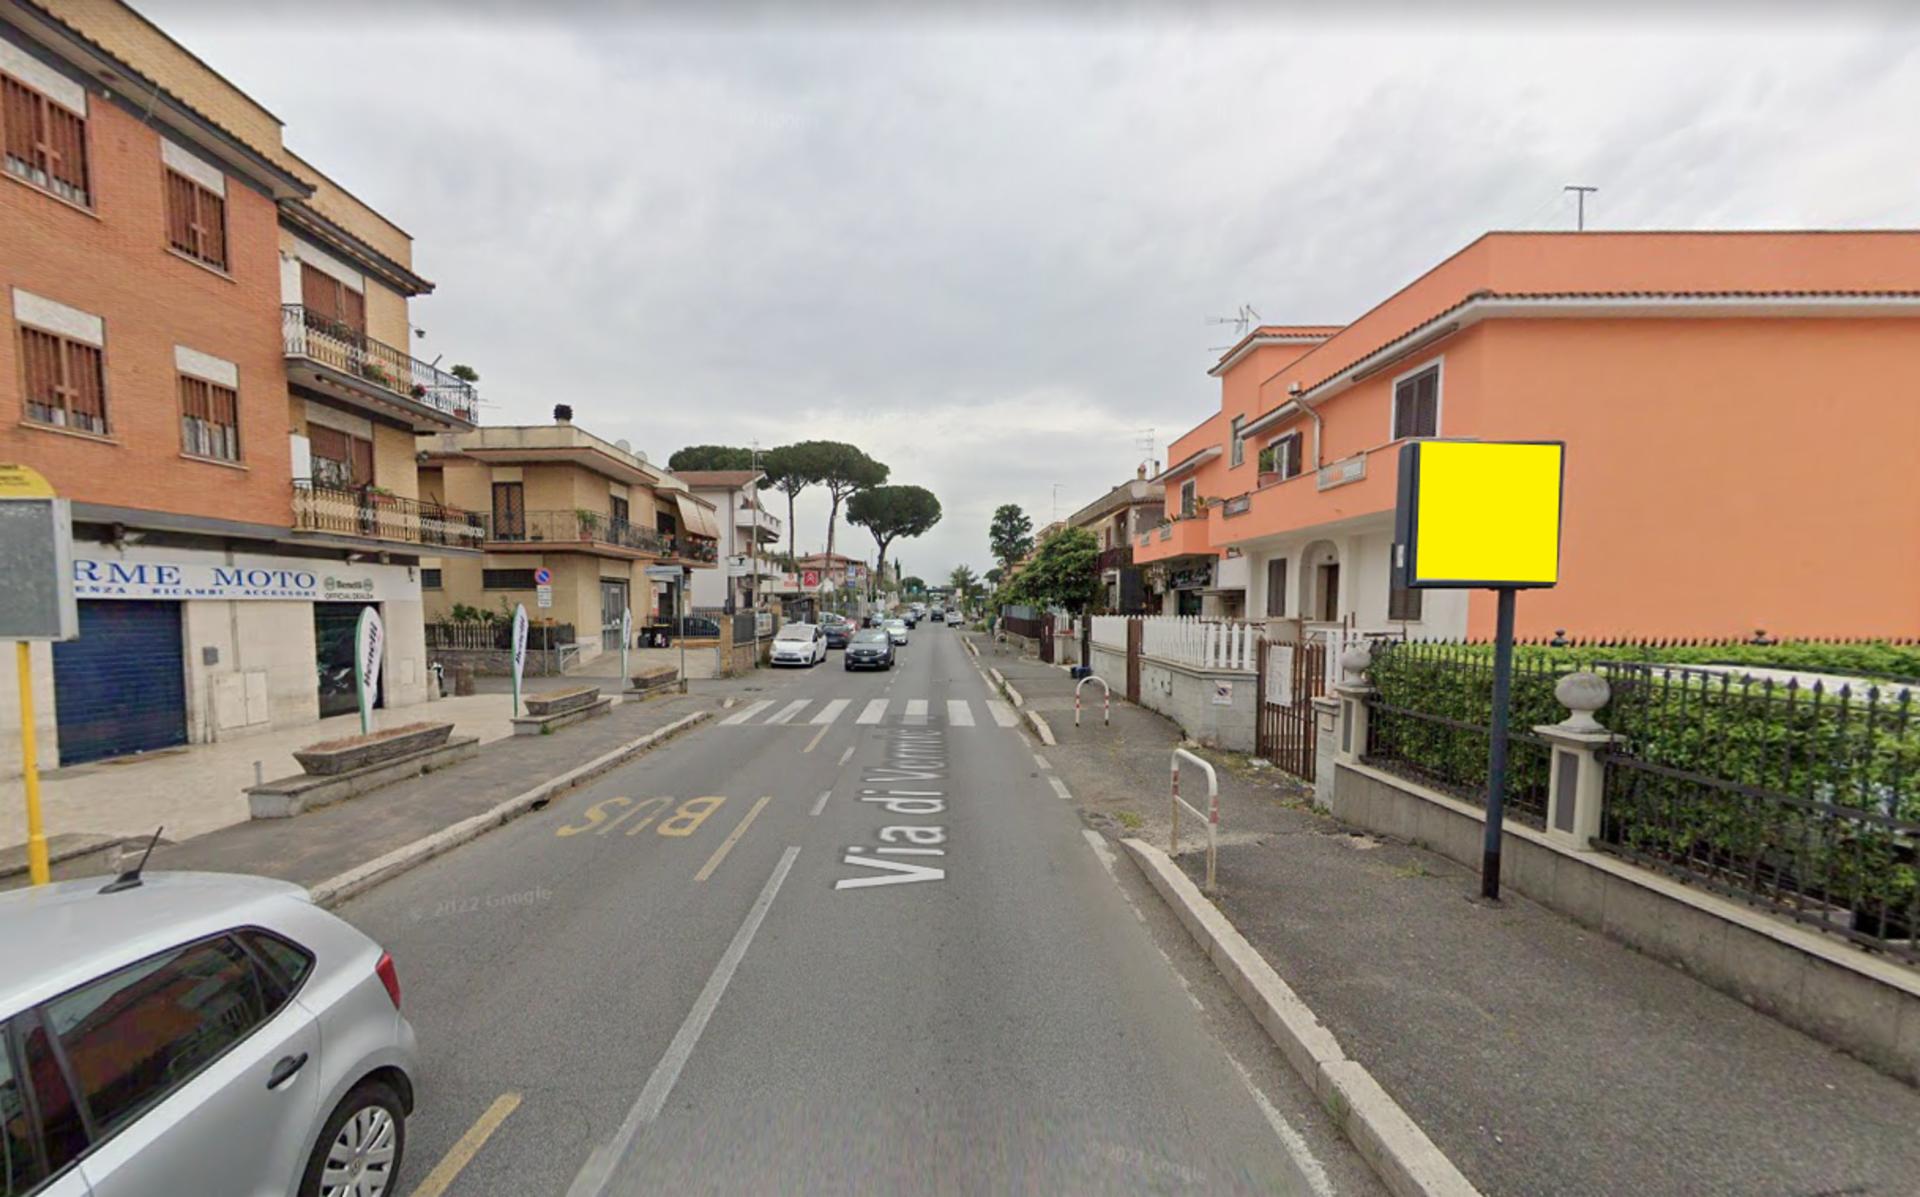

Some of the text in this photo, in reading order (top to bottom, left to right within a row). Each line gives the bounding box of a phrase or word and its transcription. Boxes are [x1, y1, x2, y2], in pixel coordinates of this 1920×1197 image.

[73, 559, 316, 589] RME MOTO
[74, 586, 316, 597] ENZA RICAMBI ACCESSORI
[556, 796, 728, 837] BUS
